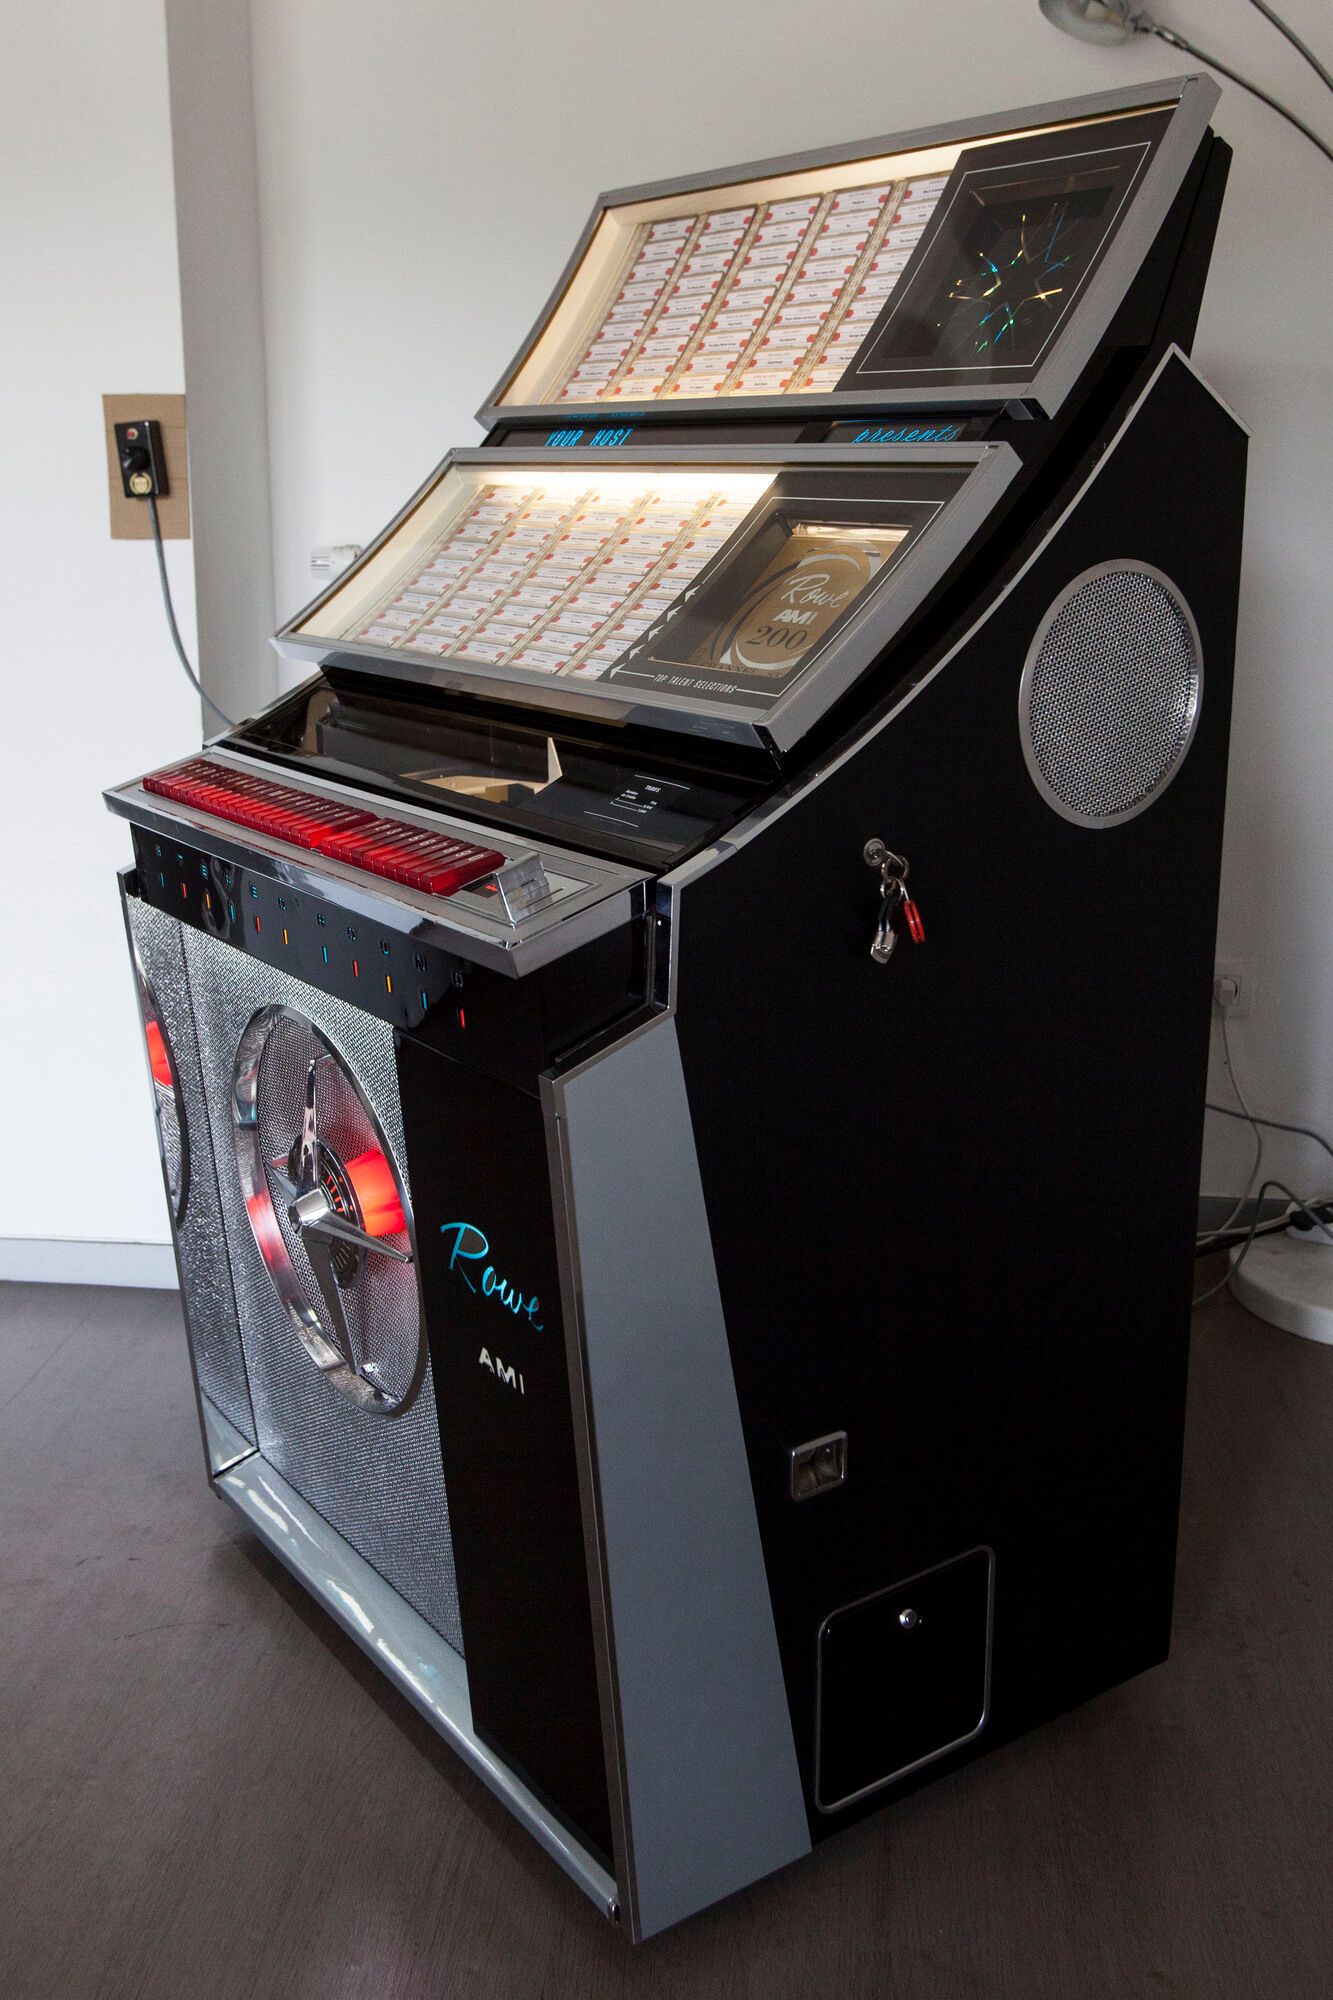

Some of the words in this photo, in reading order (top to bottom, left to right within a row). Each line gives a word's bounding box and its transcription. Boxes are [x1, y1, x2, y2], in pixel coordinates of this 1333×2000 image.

[545, 430, 584, 447] YOUR
[589, 428, 635, 446] HOST
[851, 424, 961, 444] presents
[781, 573, 849, 608] Rowe
[746, 625, 808, 650] 200
[654, 673, 667, 683] TOP
[668, 675, 693, 687] TALENT
[694, 678, 738, 694] SELECTIONS
[440, 1222, 544, 1331] Rowe
[479, 1347, 525, 1396] AMI
